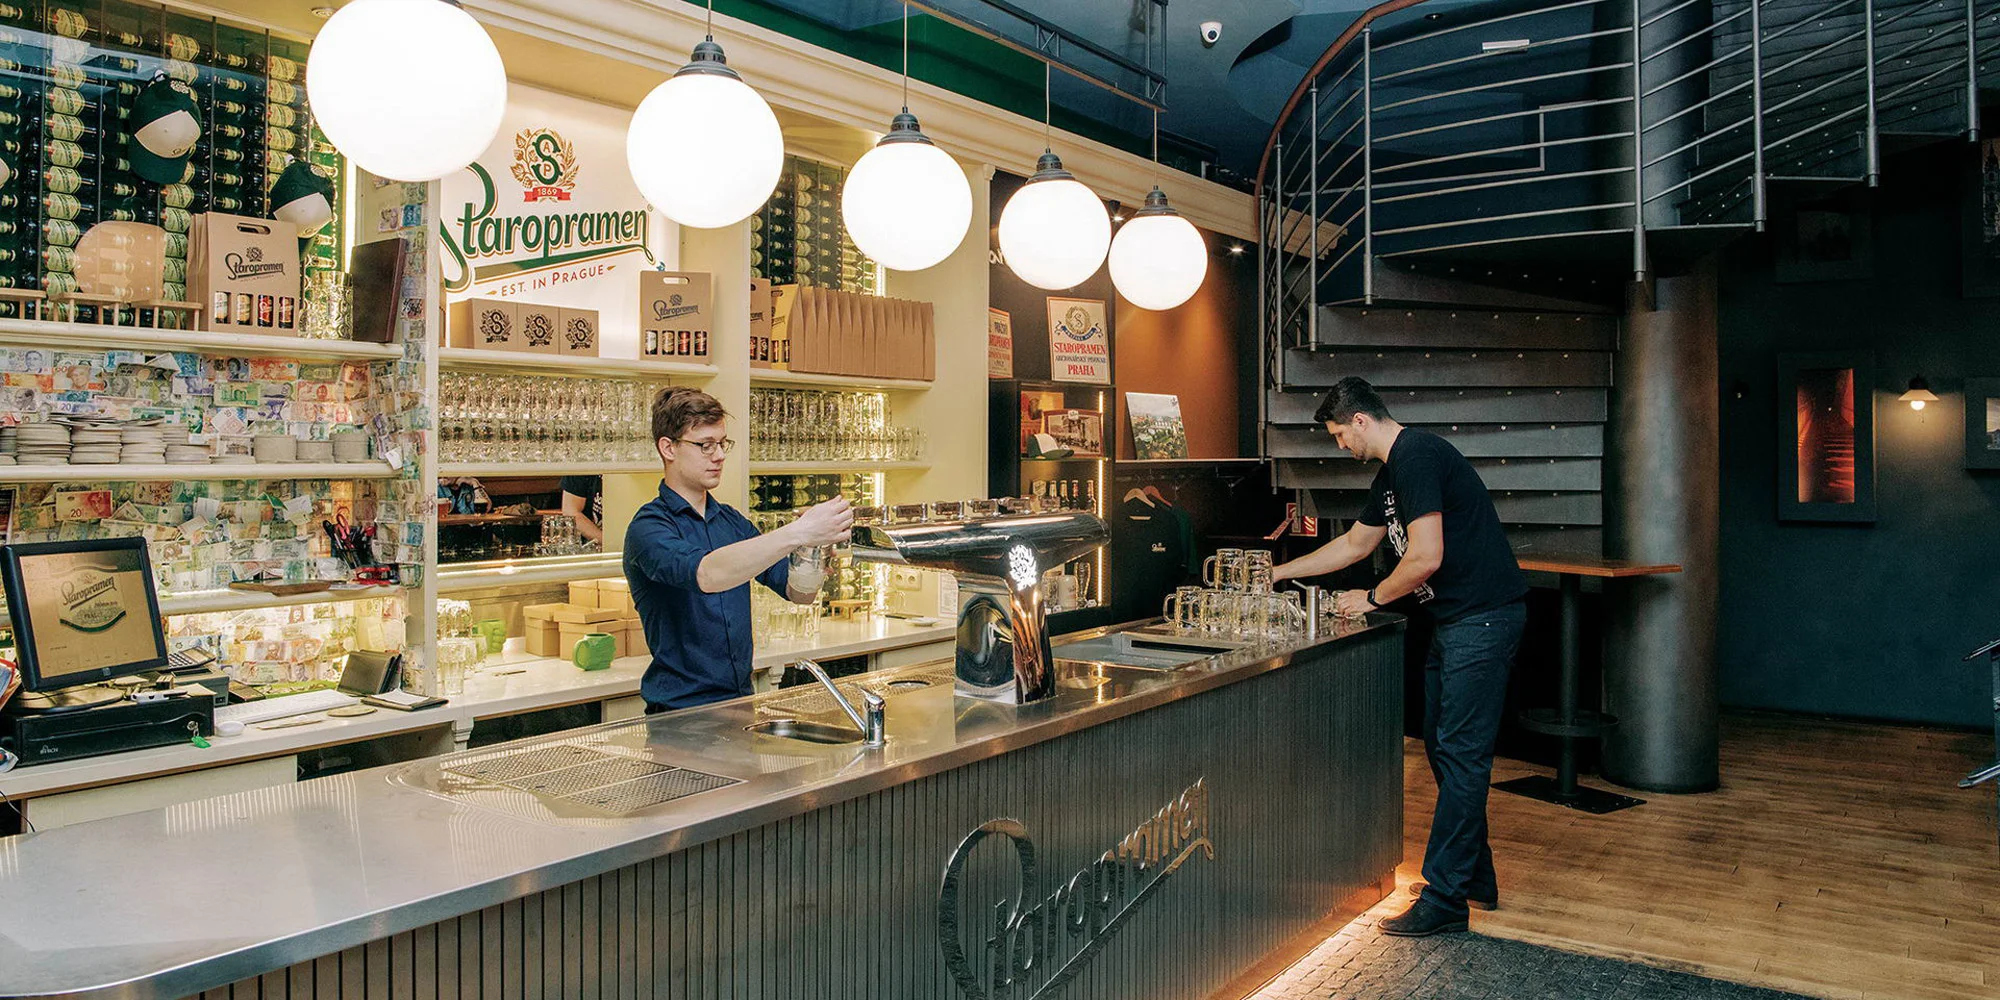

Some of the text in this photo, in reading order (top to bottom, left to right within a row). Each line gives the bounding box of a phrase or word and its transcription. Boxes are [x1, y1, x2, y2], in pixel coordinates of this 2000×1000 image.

[537, 186, 558, 197] 1869
[224, 252, 286, 280] Staropramen
[501, 264, 605, 297] EST. IN PRAGUE
[652, 300, 700, 322] Staropramen
[1053, 342, 1106, 355] STAROPRAMEN
[1067, 364, 1095, 376] PRAHA
[70, 508, 82, 518] 20
[61, 576, 117, 610] Staropramen
